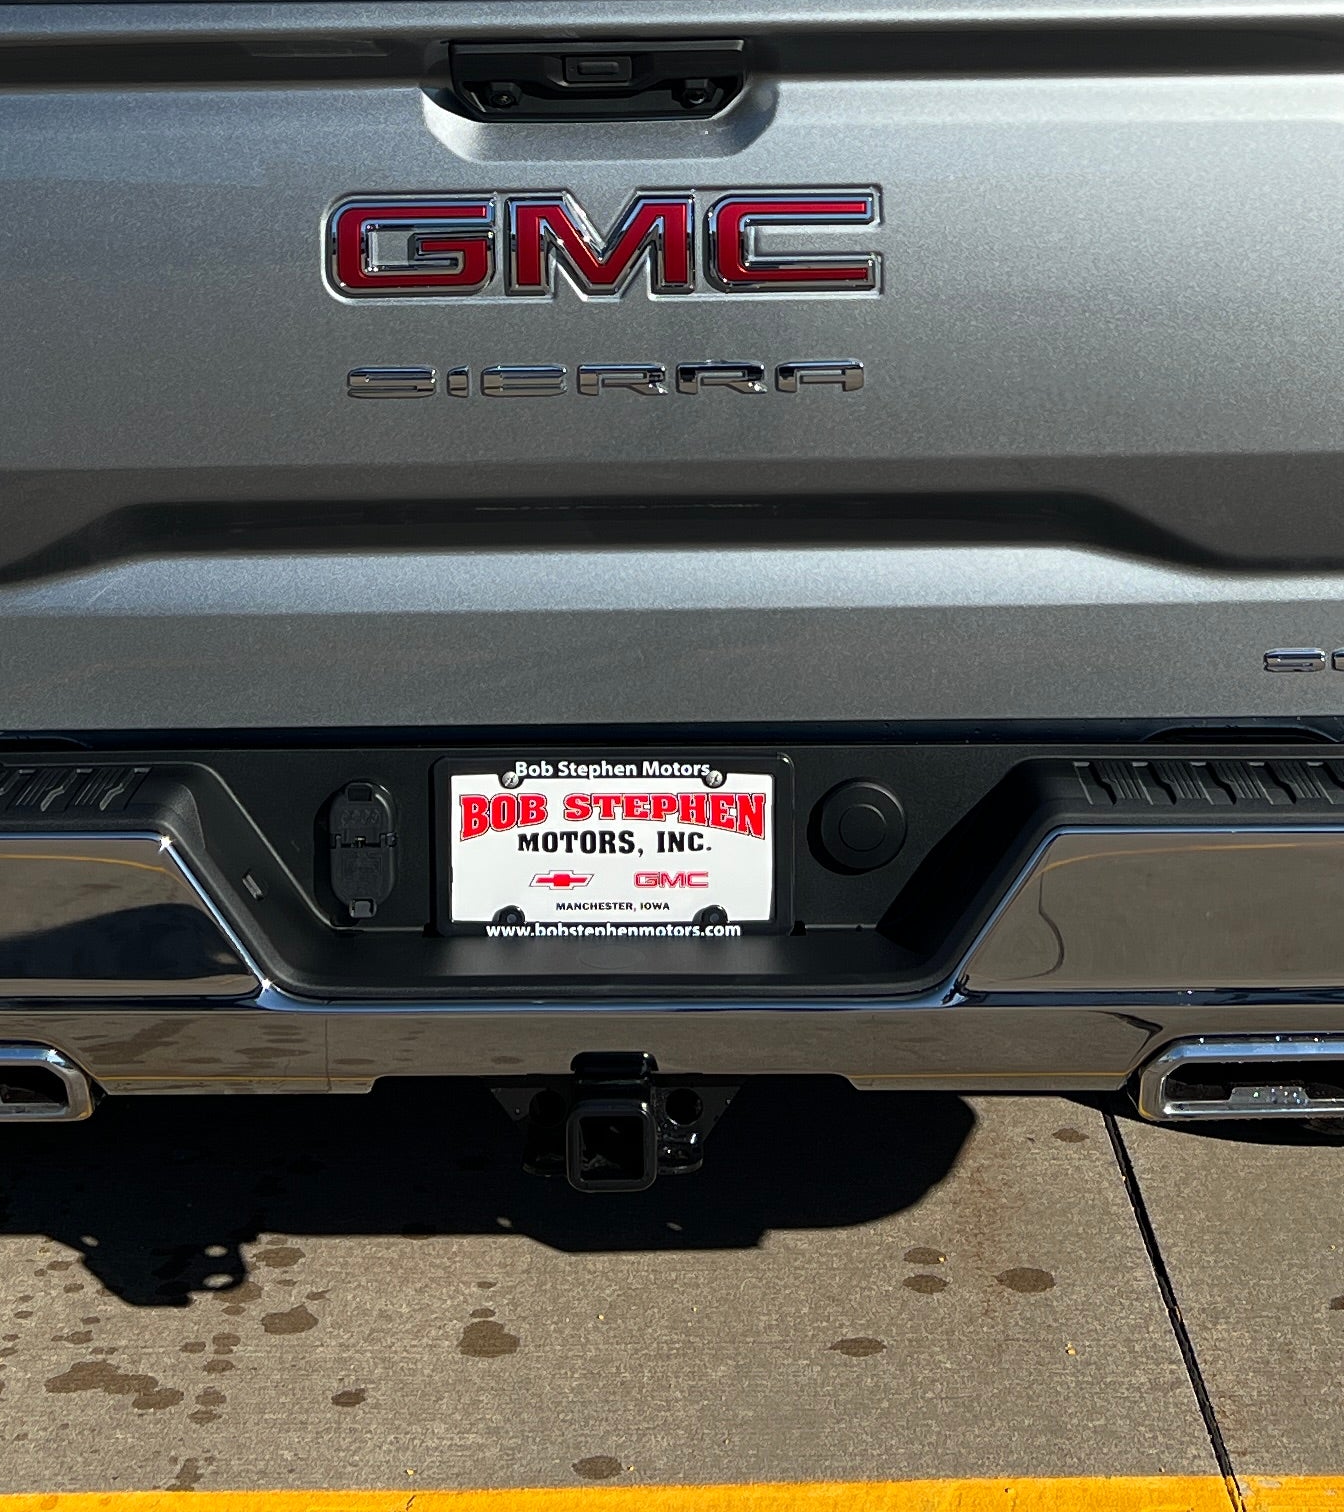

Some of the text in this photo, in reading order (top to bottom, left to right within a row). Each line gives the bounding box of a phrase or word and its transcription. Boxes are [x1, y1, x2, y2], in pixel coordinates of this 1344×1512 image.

[326, 187, 882, 301] GMC
[347, 358, 865, 399] SIERRA
[515, 762, 711, 780] Bob Stephen Motors
[459, 792, 767, 842] BOB STEPHEN
[517, 830, 712, 858] MOTORS, INC.
[633, 870, 709, 889] GMC
[556, 901, 670, 912] MANCHESTER, IOWA
[486, 922, 741, 937] www.bobstephenmotors.com
